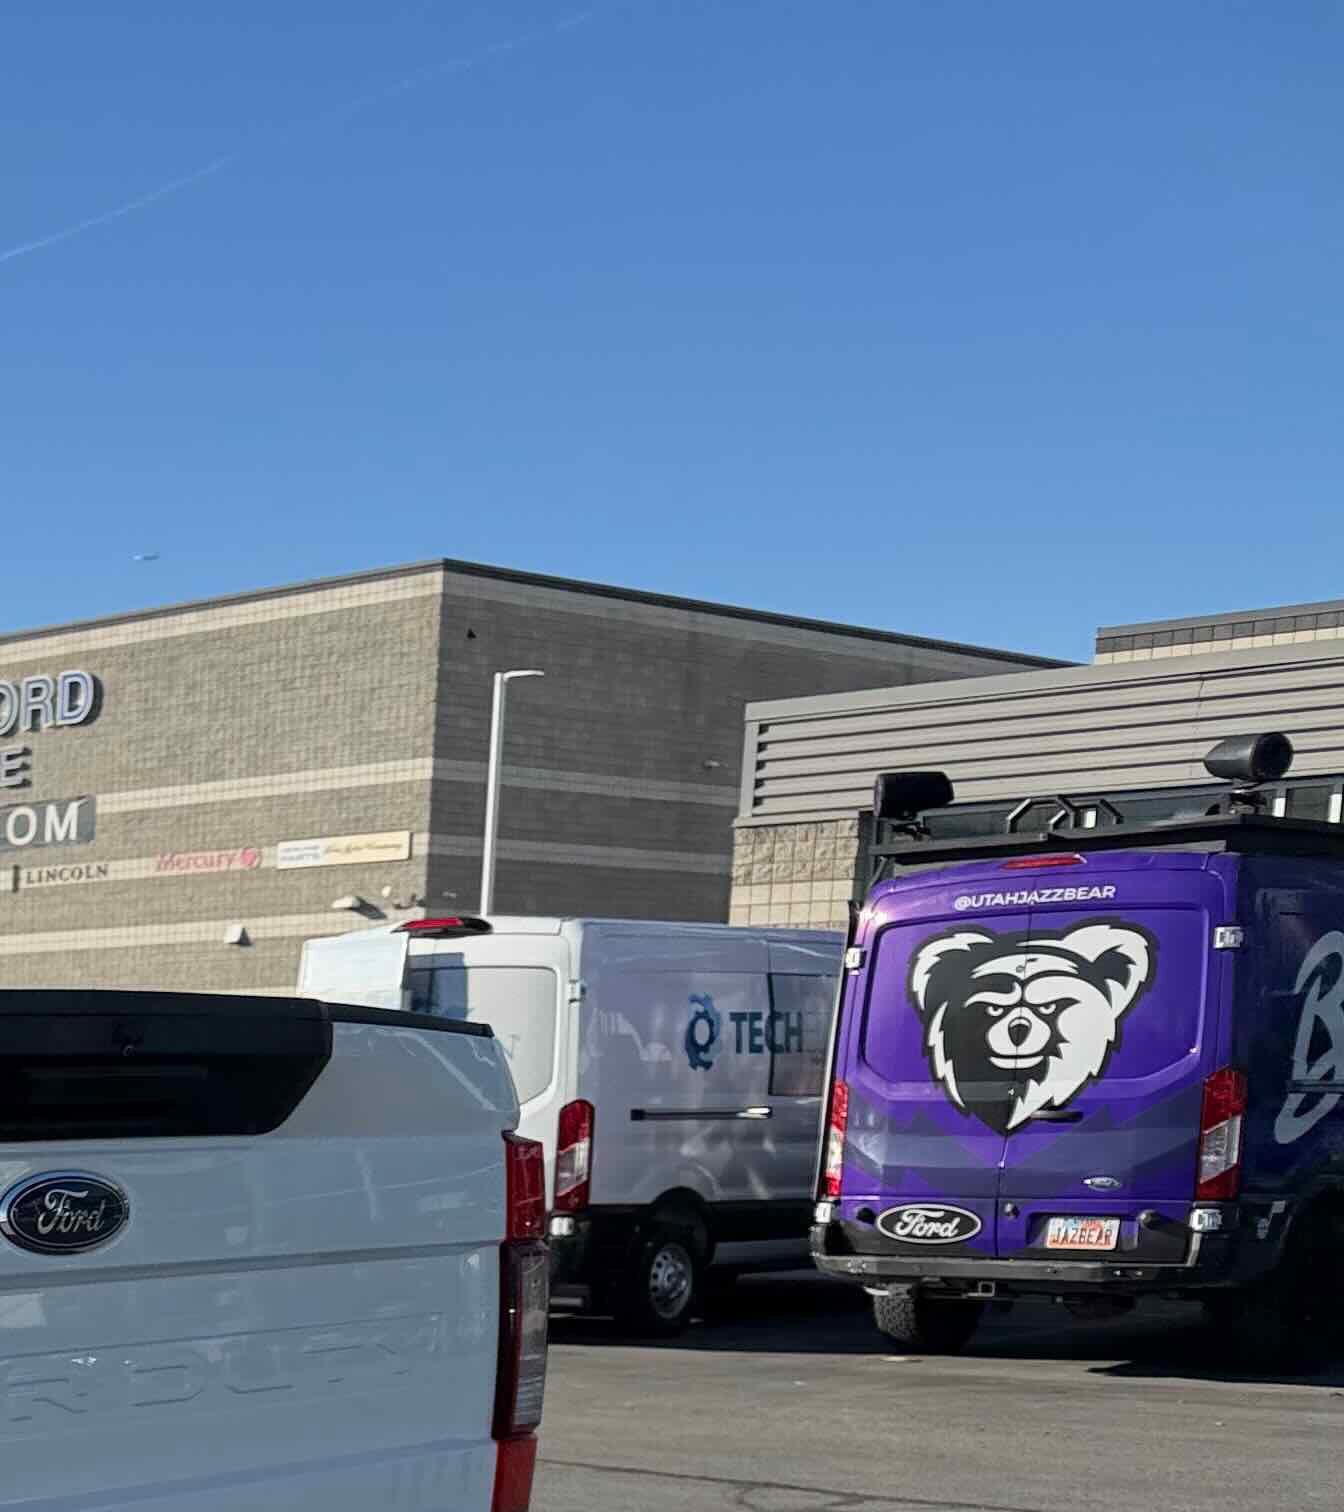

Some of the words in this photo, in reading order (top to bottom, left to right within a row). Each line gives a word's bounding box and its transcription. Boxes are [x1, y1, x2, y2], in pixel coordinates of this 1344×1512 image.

[25, 862, 110, 884] LINCOLN
[155, 852, 237, 871] Mercury
[953, 885, 1117, 912] @UTAHJAZZBEAR
[729, 1010, 803, 1054] TECH
[36, 1188, 106, 1235] Ford
[893, 1208, 961, 1238] Ford
